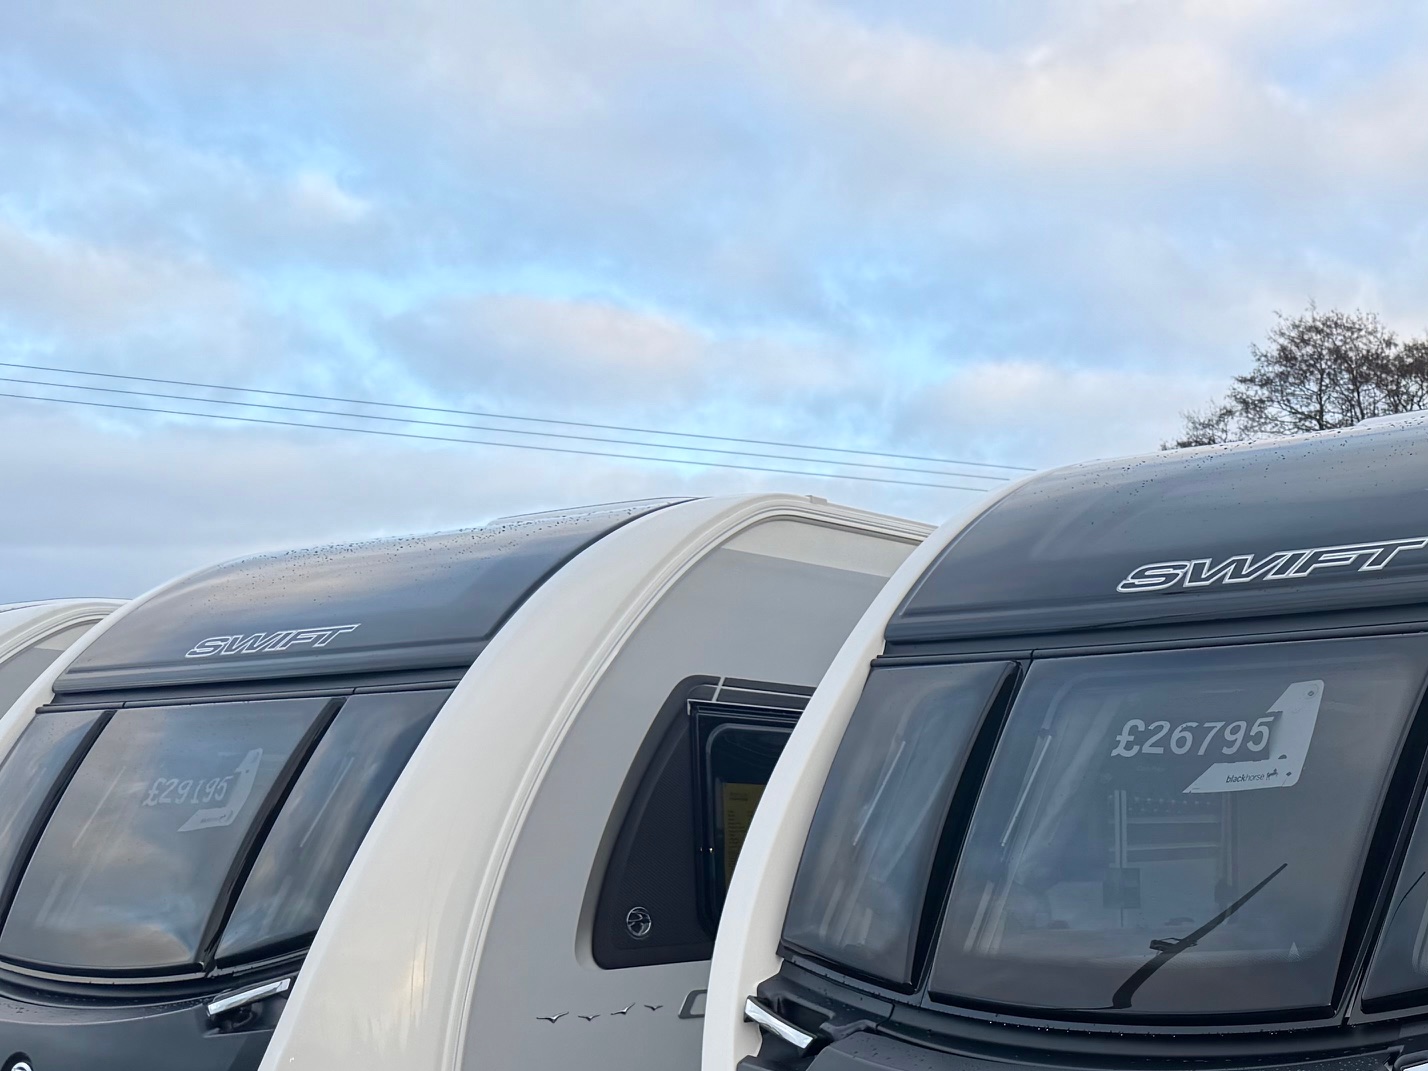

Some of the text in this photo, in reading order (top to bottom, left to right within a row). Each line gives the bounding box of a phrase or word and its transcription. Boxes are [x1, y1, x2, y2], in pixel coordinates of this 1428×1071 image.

[184, 622, 362, 659] SWIFT
[1110, 716, 1275, 758] £26795
[142, 775, 234, 807] £29195
[1225, 773, 1265, 784] blackhorse
